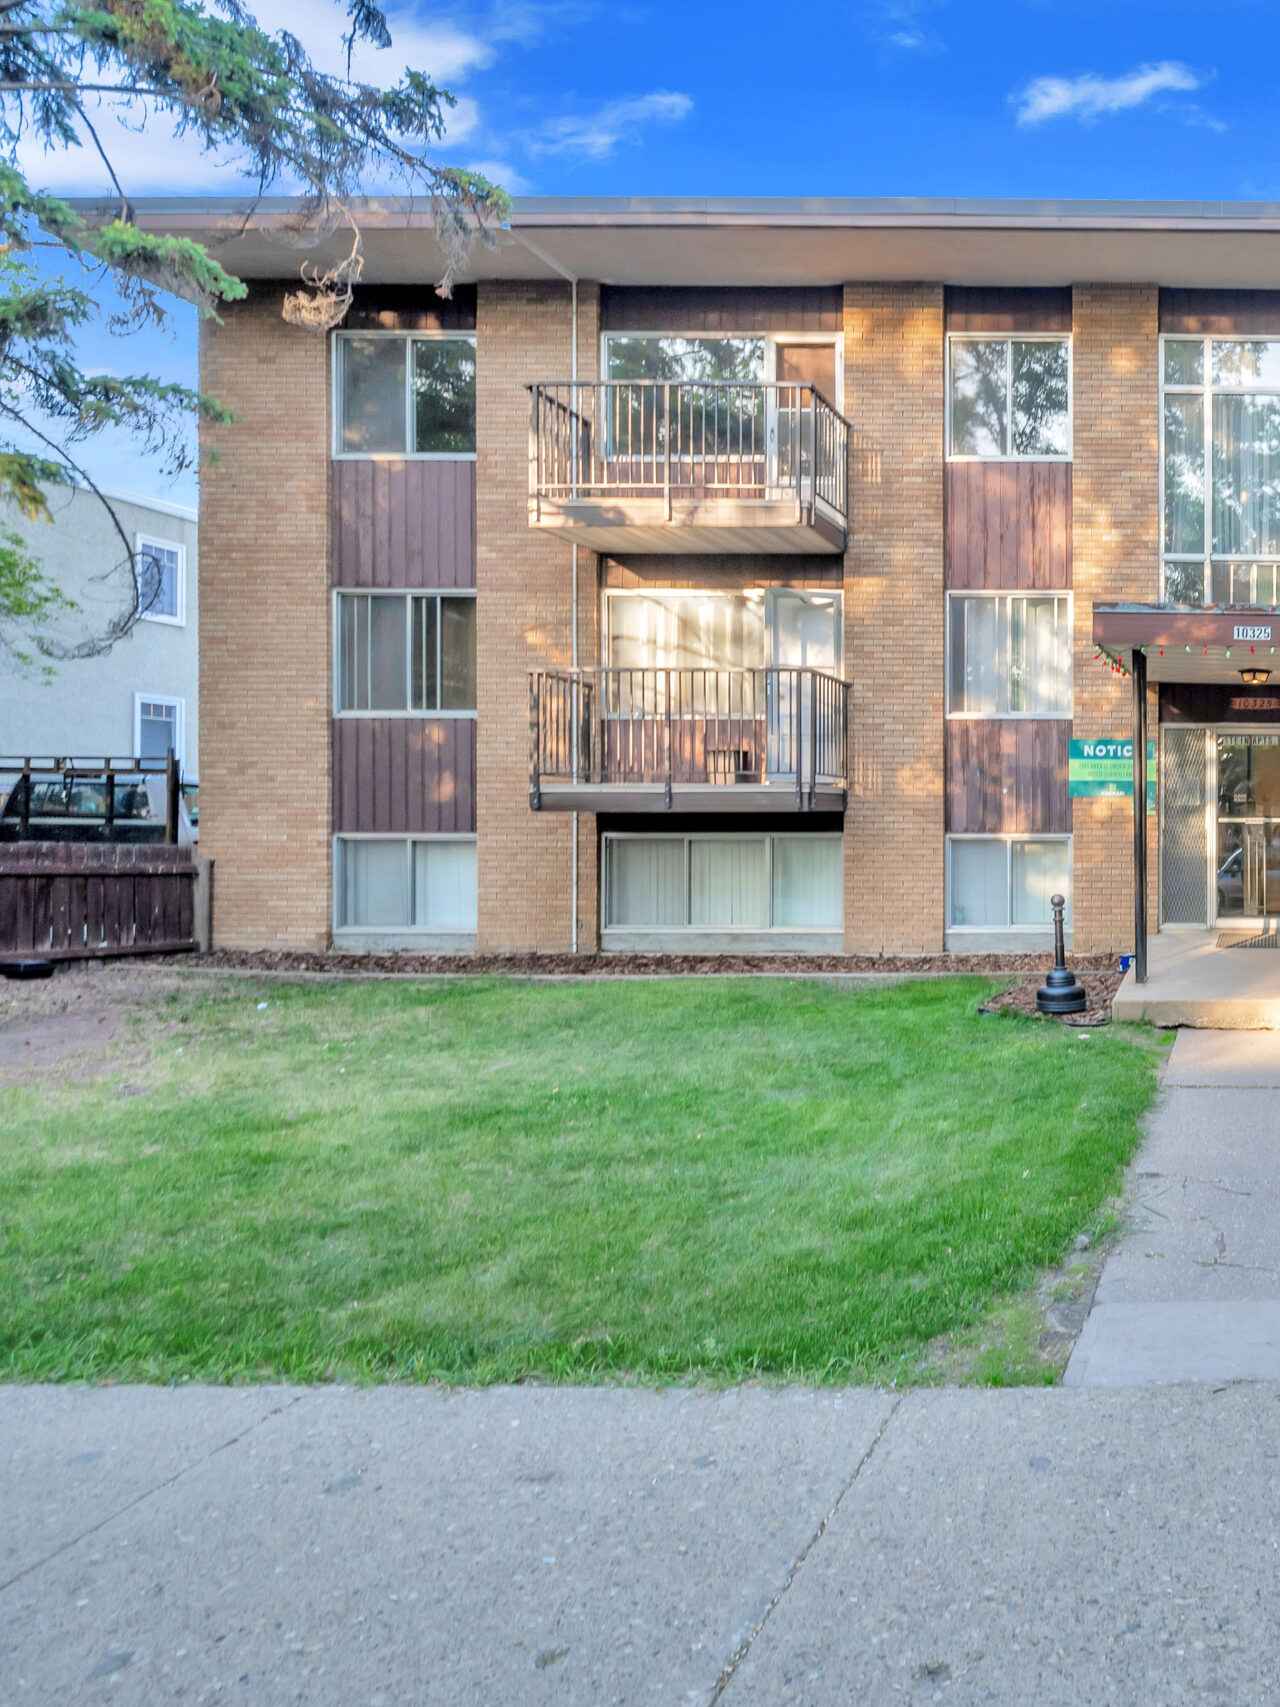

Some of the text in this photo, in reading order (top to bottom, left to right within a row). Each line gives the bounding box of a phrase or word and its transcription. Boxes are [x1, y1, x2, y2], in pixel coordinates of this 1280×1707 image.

[1236, 627, 1270, 639] 10325
[1238, 698, 1273, 708] 10325
[1083, 745, 1133, 757] NOTIC
